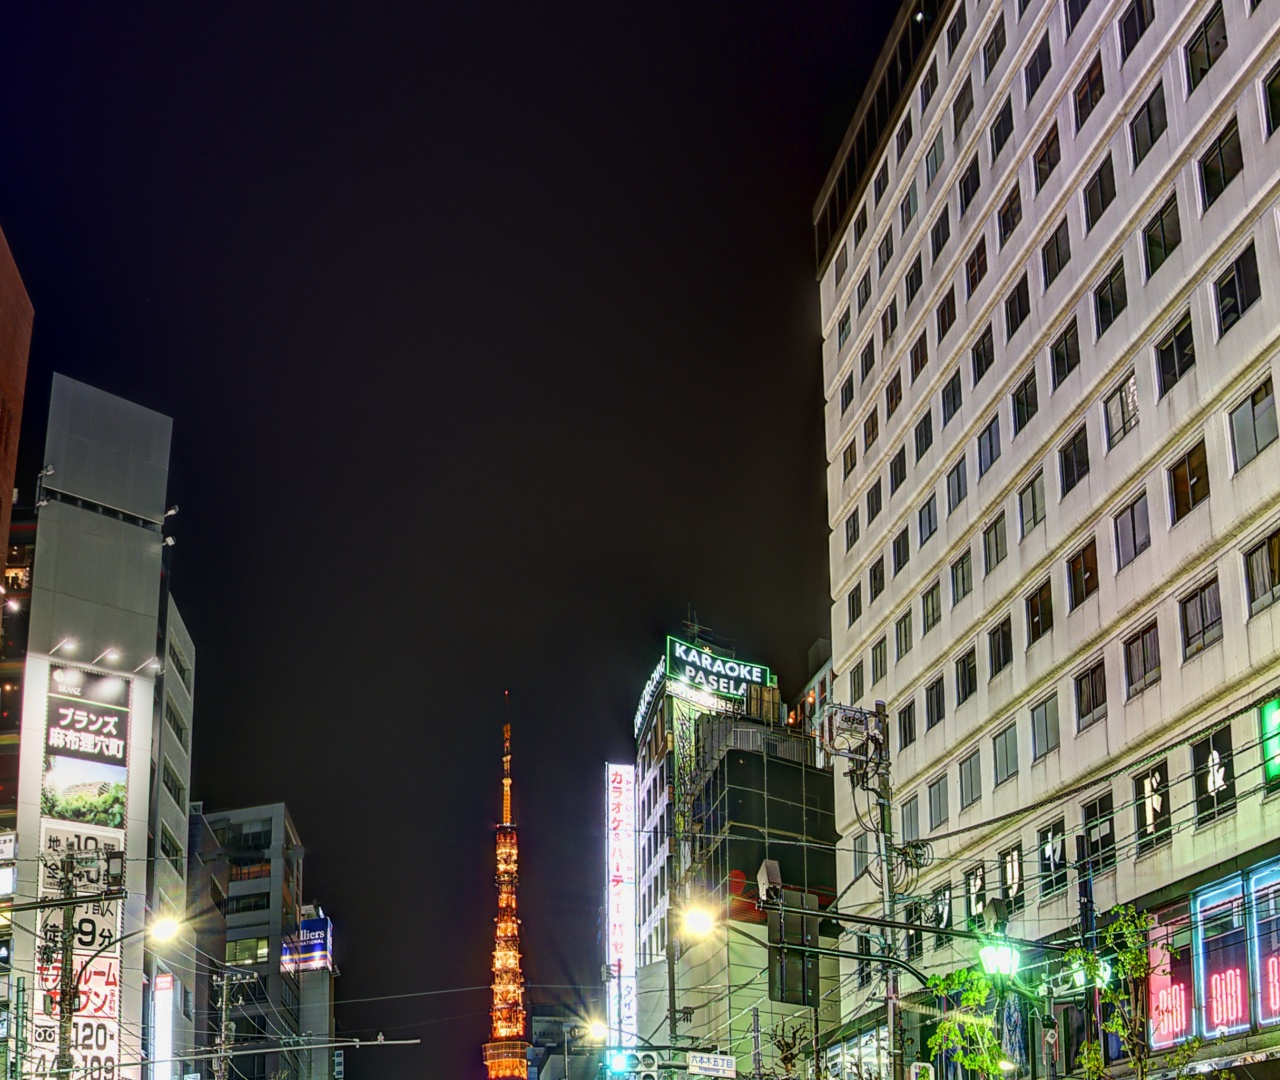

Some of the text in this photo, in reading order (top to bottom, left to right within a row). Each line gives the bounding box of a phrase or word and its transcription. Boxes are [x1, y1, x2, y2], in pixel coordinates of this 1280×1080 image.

[675, 642, 762, 682] KARAOKE
[685, 665, 747, 696] PASELA
[58, 708, 119, 735] ブランズ
[48, 727, 124, 758] 麻布狸穴町
[691, 1055, 733, 1068] 六本木五丁目
